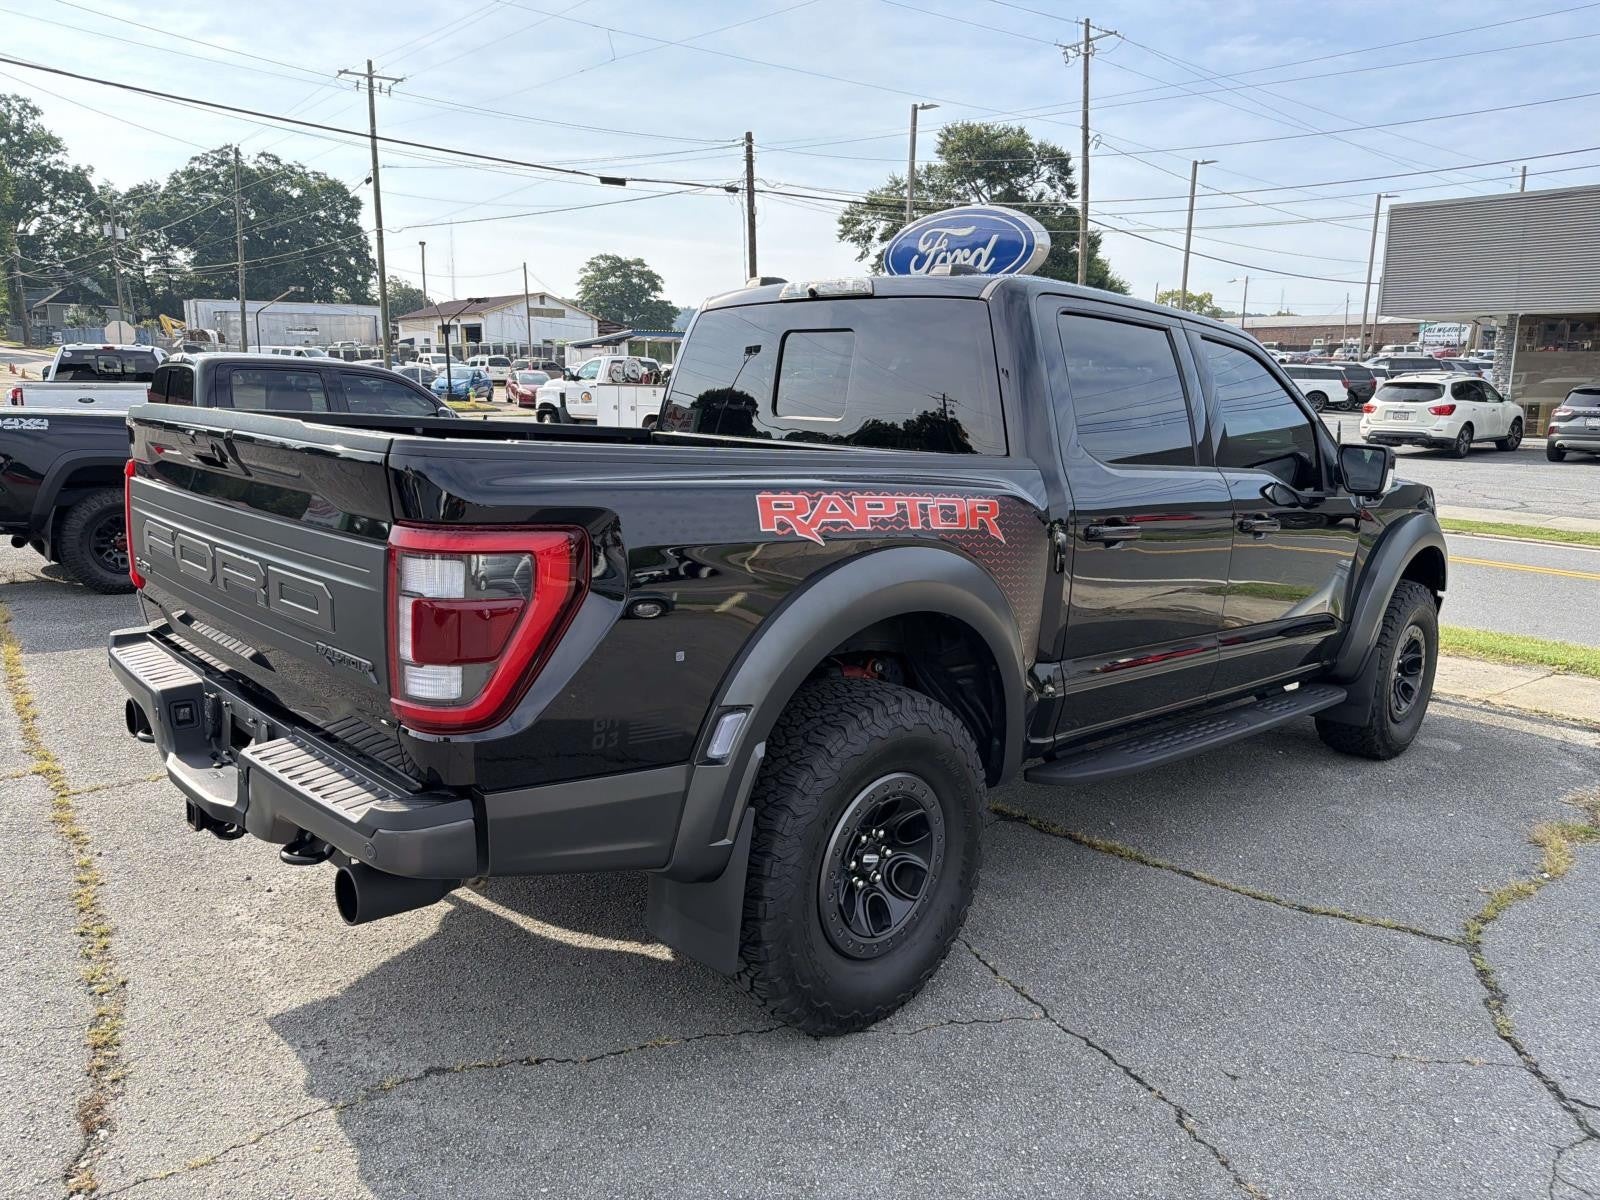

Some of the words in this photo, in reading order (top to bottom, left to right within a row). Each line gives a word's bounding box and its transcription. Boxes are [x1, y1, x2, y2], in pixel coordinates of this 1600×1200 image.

[909, 225, 999, 275] Ford
[755, 493, 1007, 546] RAPTOR
[143, 518, 336, 634] FORD
[315, 640, 380, 685] RAPTOR
